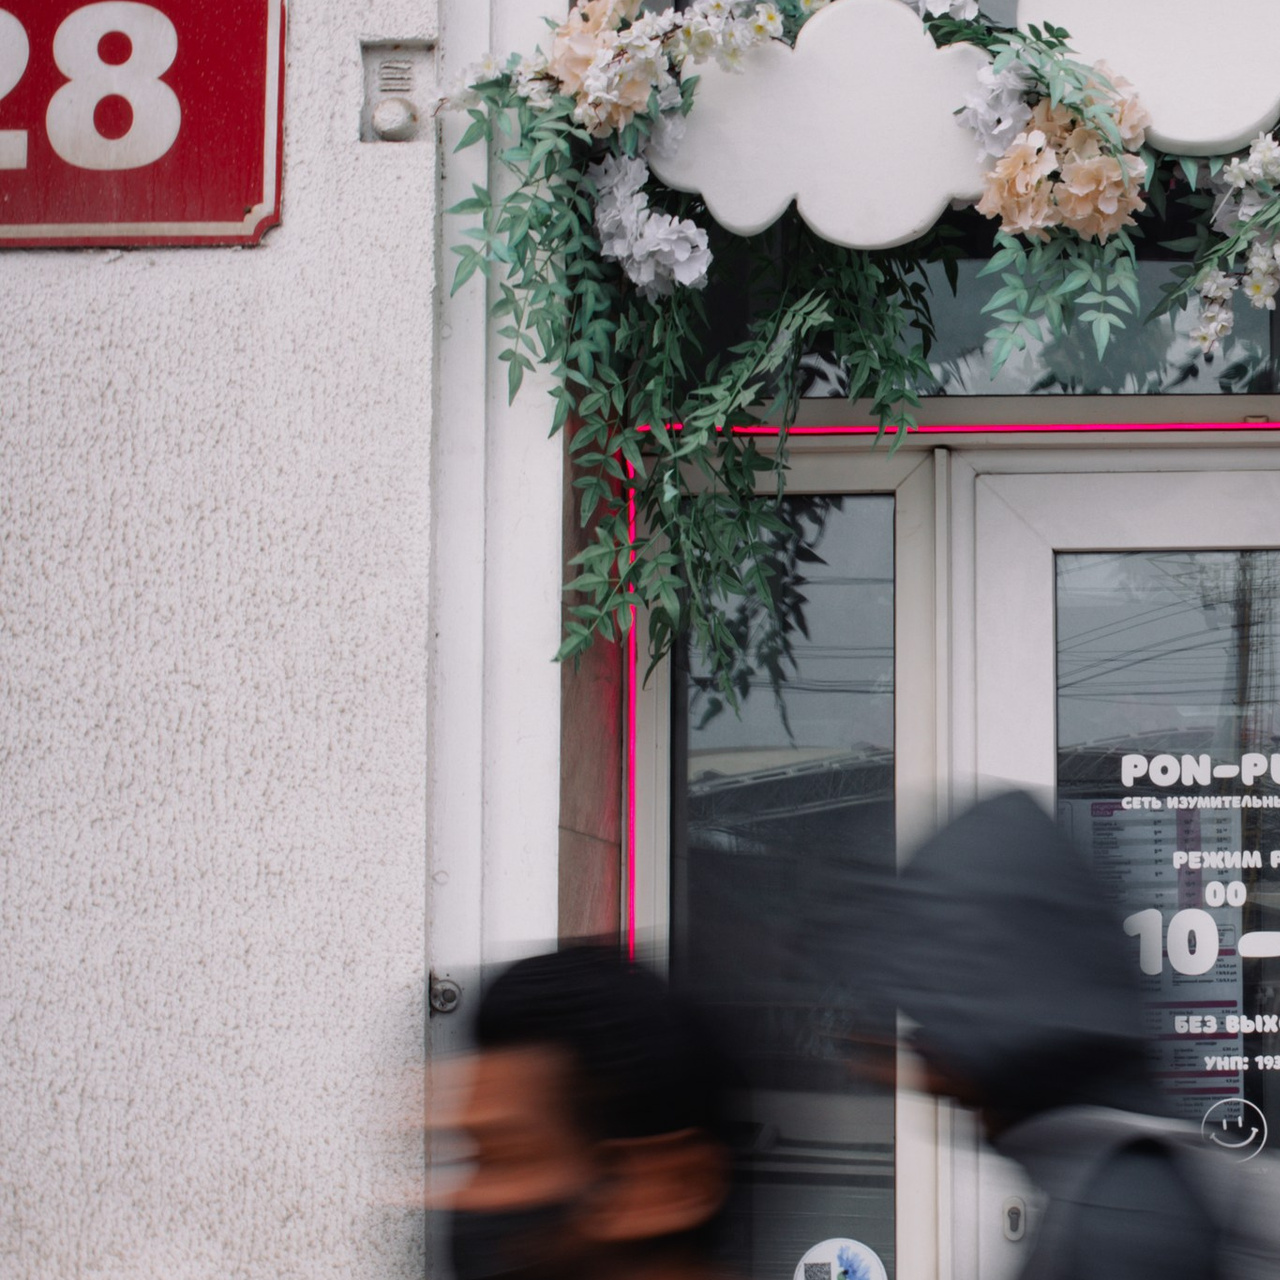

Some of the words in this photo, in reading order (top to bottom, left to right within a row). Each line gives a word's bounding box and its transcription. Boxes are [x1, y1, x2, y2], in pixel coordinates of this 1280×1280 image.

[1121, 796, 1162, 809] СЕТЬ
[1172, 850, 1262, 869] РЕЖИМ
[1205, 881, 1247, 907] 00
[1123, 908, 1219, 976] 10
[1174, 1015, 1218, 1034] БЕЗ
[1204, 1056, 1249, 1071] УНП:
